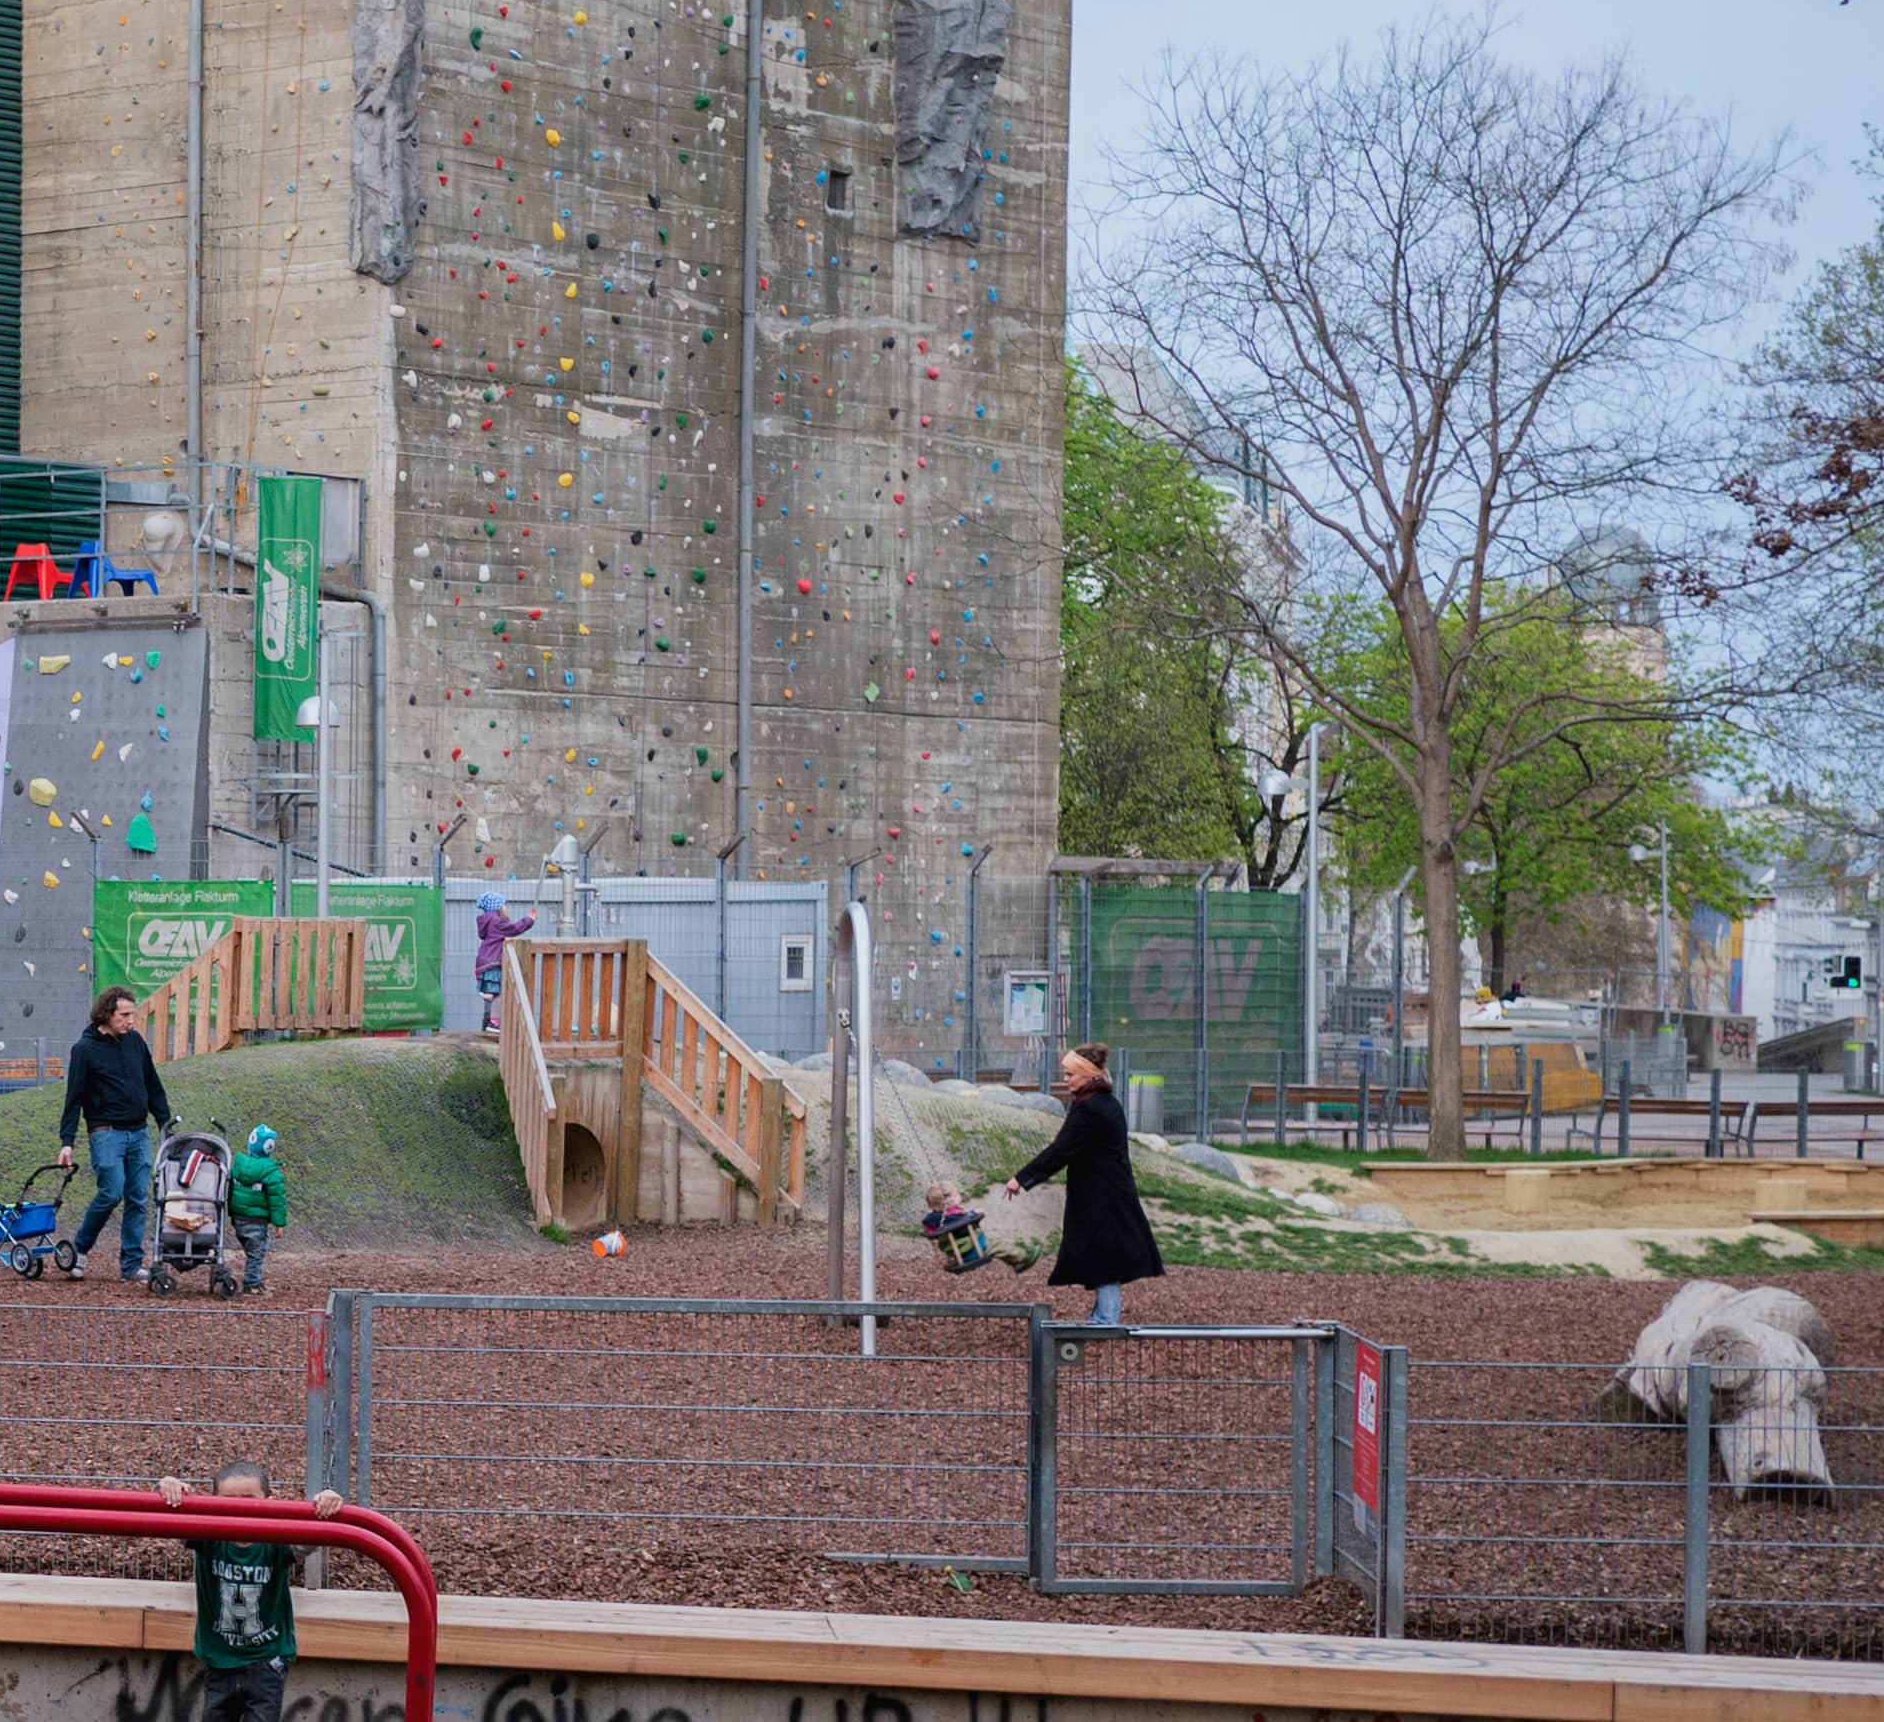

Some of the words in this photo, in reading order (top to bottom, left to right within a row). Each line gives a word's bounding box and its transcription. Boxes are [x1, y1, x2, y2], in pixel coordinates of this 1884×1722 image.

[128, 890, 192, 906] Kletteranlage
[194, 890, 239, 903] Flakturm
[219, 1578, 263, 1637] H
